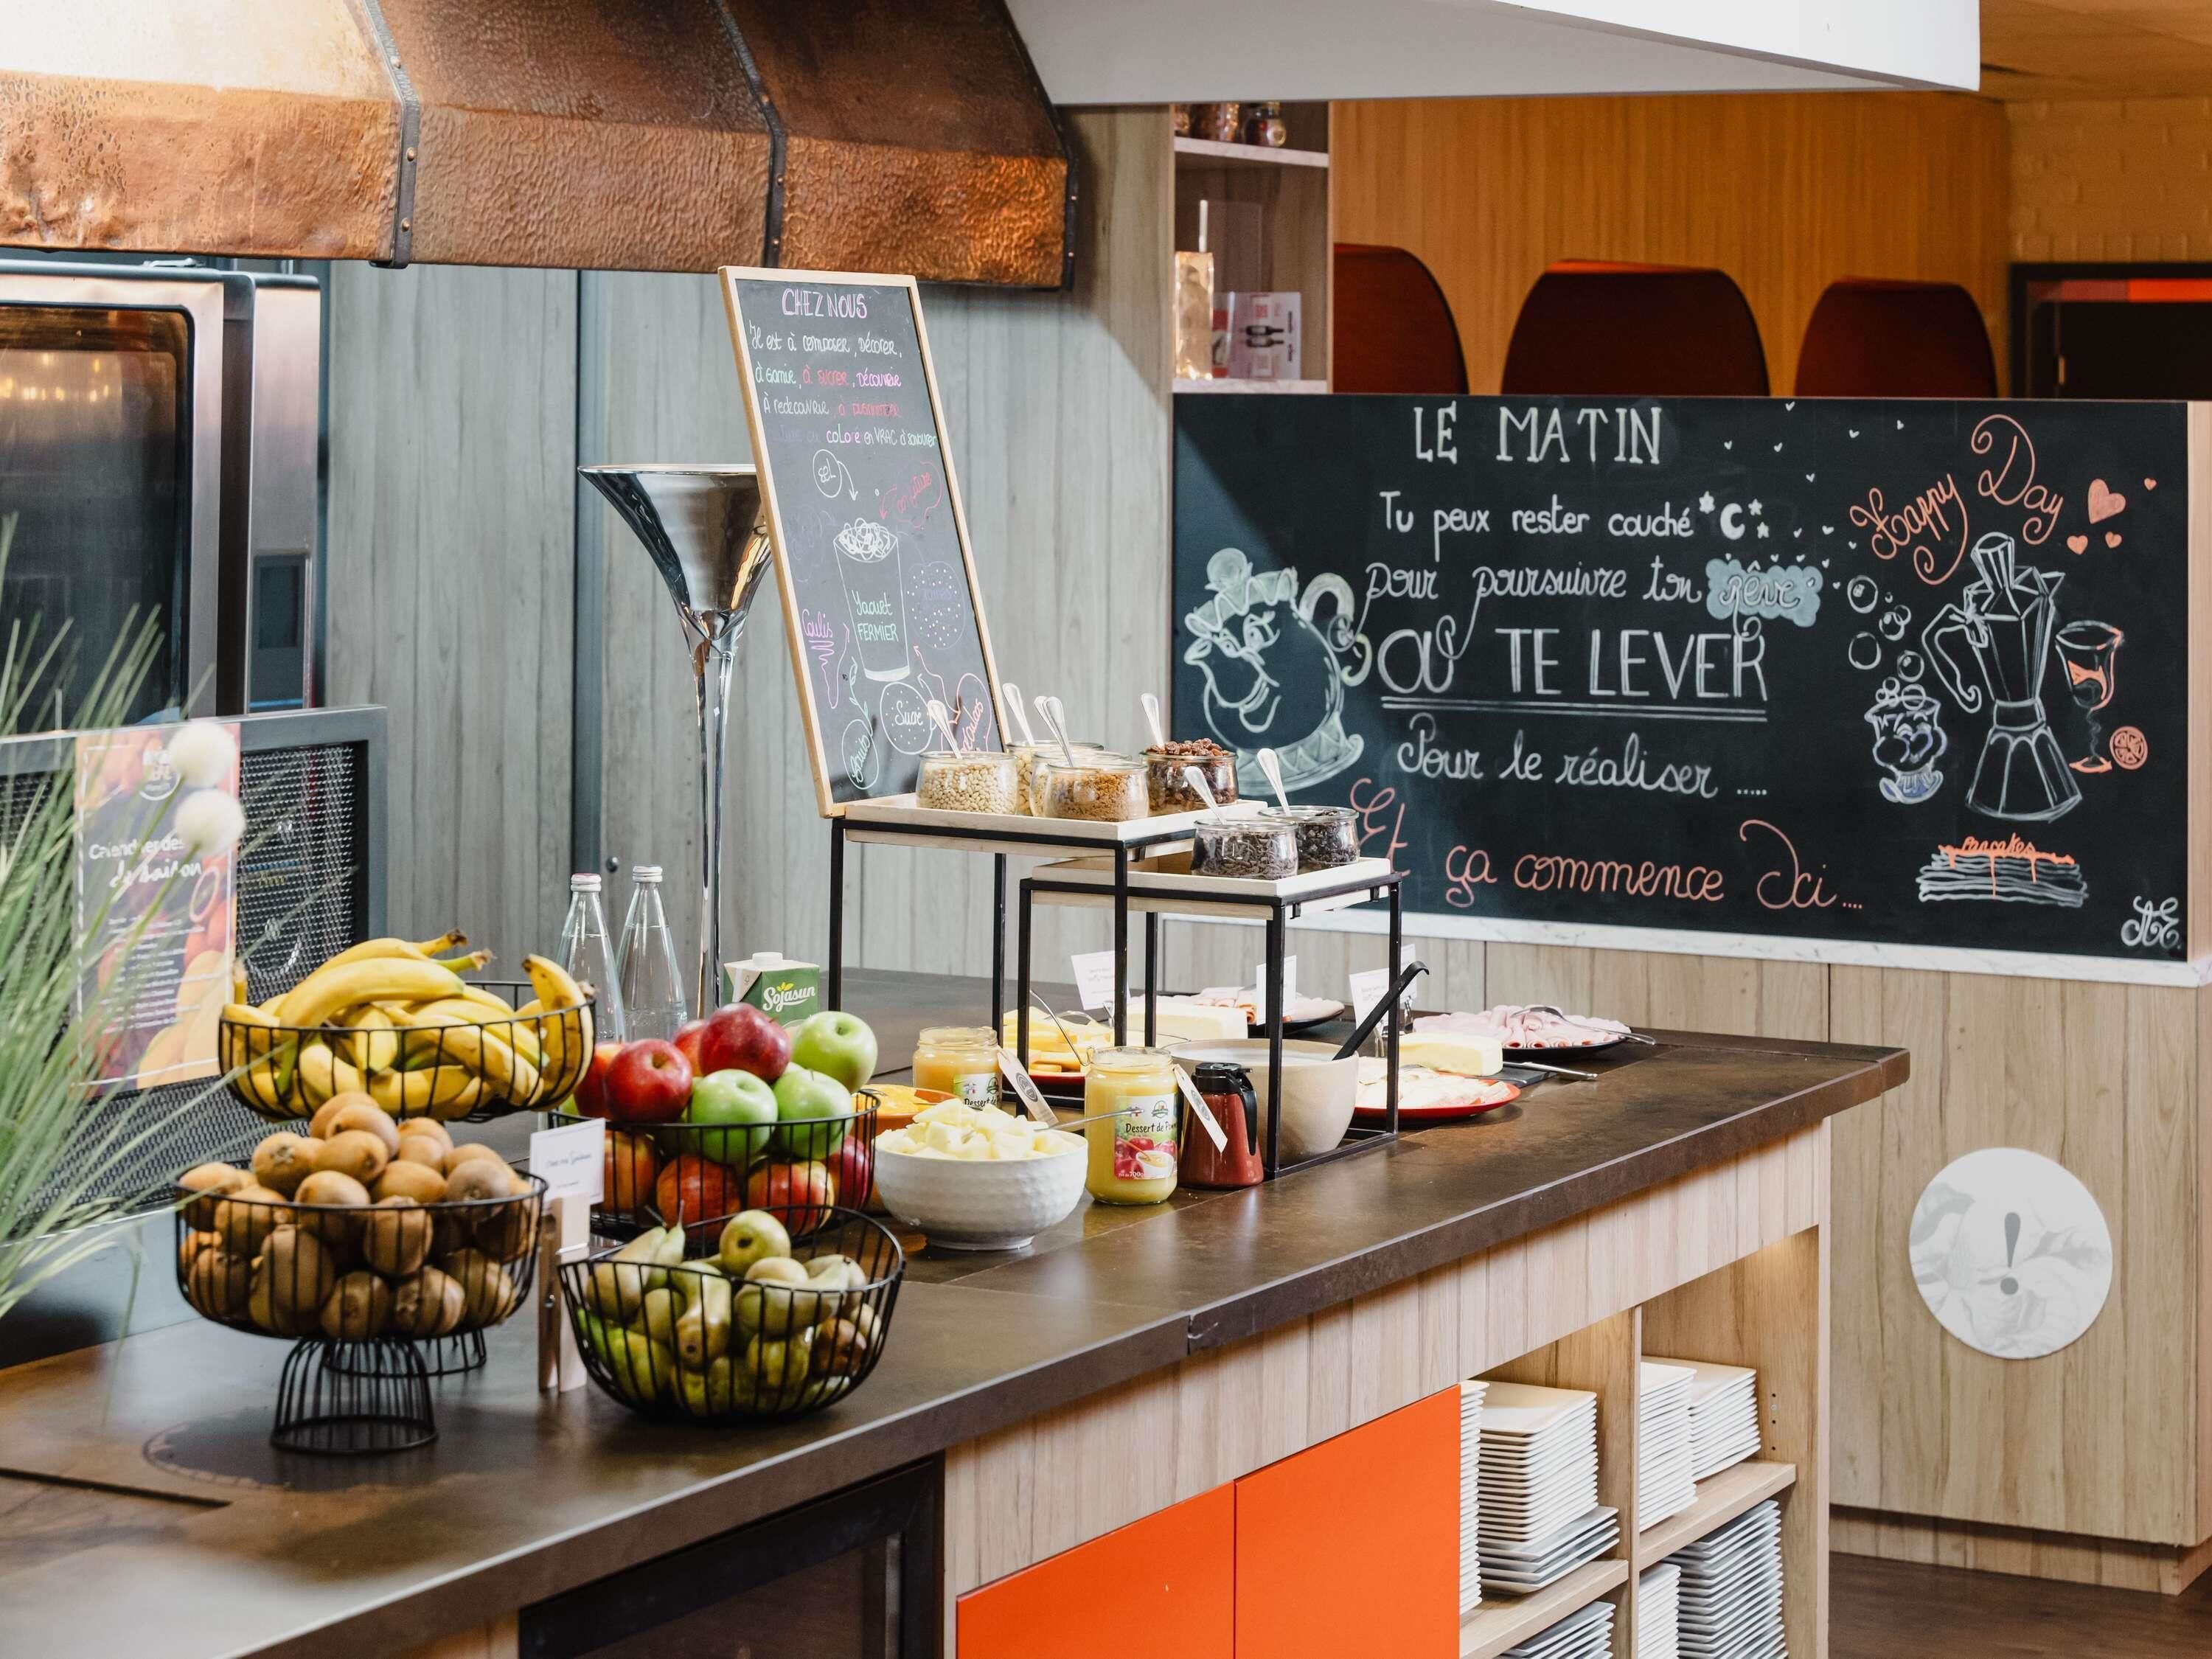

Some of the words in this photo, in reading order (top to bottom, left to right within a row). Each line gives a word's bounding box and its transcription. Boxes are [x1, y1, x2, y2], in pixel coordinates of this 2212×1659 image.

[782, 288, 824, 317] CHEZ
[827, 293, 868, 319] NOUS
[766, 333, 782, 351] est
[787, 333, 796, 351] à
[1413, 400, 1458, 465] LE
[1495, 406, 1663, 466] MATIN
[1380, 490, 1414, 534] Tu
[1433, 507, 1491, 563] peux
[1512, 493, 1590, 534] rester
[1607, 501, 1694, 538] couché
[1849, 472, 1969, 586] Happy
[1970, 414, 2064, 545] Day
[1355, 562, 1439, 623] pour
[1464, 560, 1627, 623] poursuivre
[1642, 554, 1703, 604] ton
[801, 608, 834, 639] Coulis
[1495, 627, 1562, 696] TE
[1590, 628, 1769, 702] LEVER
[1397, 712, 1484, 780] Pour
[1498, 728, 1543, 782] le
[1555, 732, 1719, 799] réaliser
[1445, 844, 1498, 908] ça
[1514, 852, 1725, 902] commence
[762, 986, 816, 1013] Sojasun
[1125, 1122, 1155, 1134] Dessert
[1156, 1121, 1164, 1133] de
